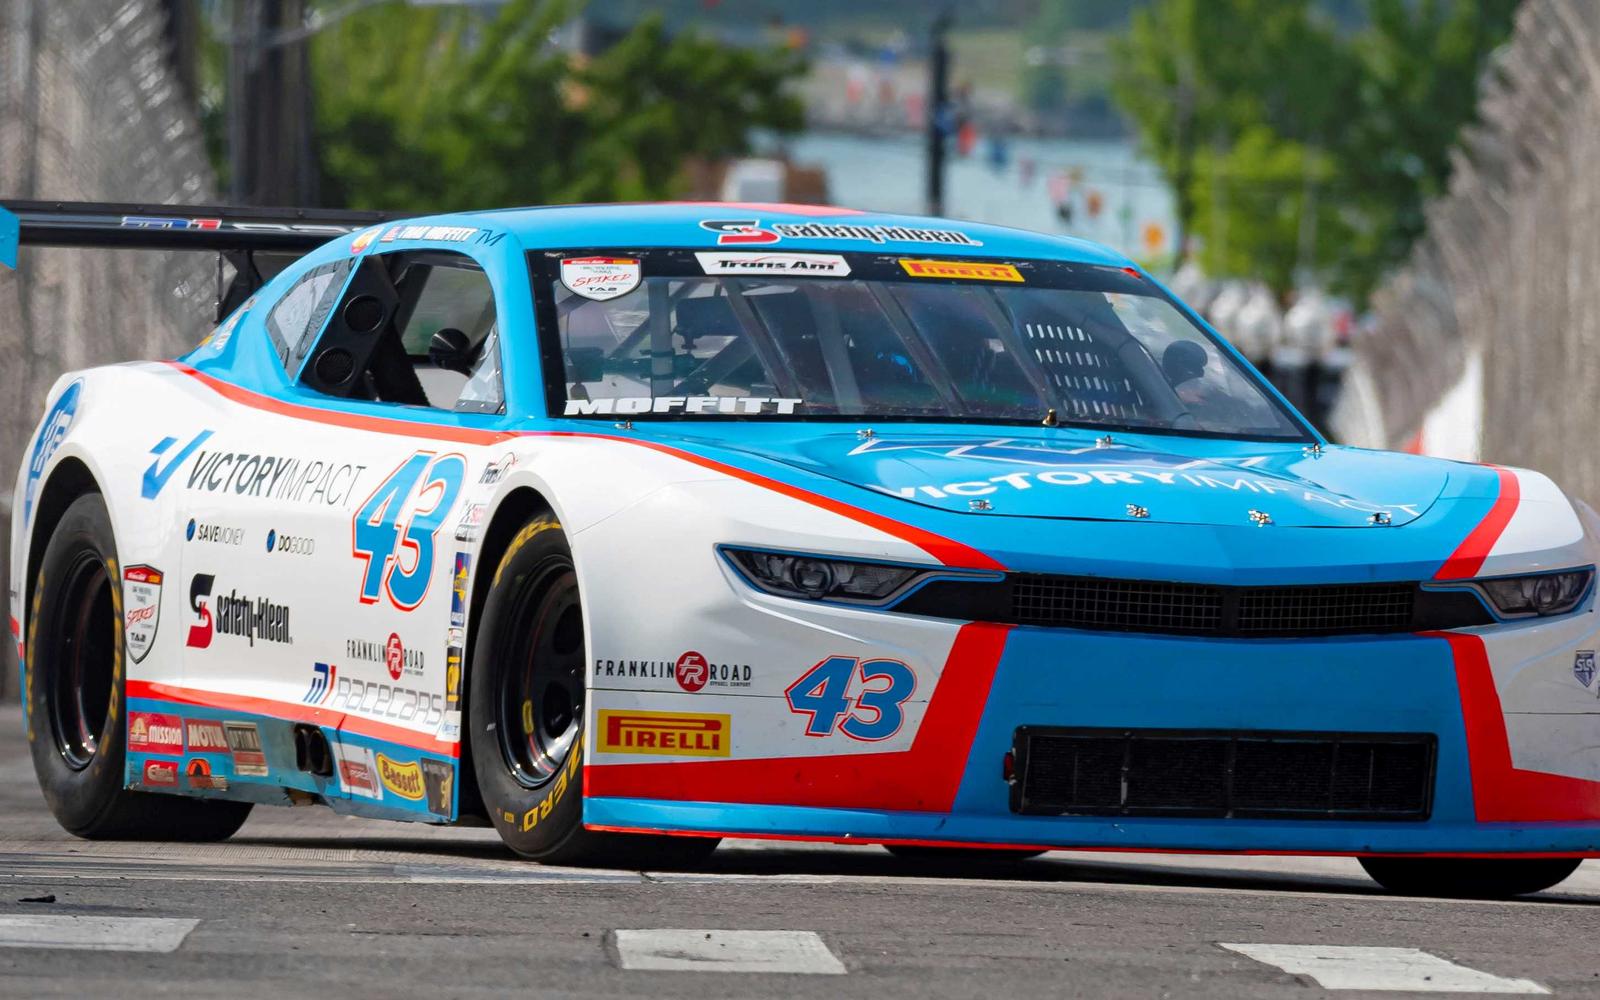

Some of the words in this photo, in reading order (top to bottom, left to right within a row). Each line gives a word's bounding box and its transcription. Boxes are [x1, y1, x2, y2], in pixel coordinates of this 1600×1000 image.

[719, 259, 785, 269] Trans
[790, 260, 834, 270] Am
[911, 263, 1013, 279] PIRELLI
[564, 397, 802, 416] MOFFITT
[352, 450, 468, 612] 43
[347, 640, 386, 662] FRANKLIN
[404, 649, 425, 670] ROAD
[595, 659, 674, 678] FRANKLIN
[710, 664, 752, 681] ROAD
[784, 655, 918, 742] 43
[188, 725, 228, 748] MOTUL
[607, 715, 722, 751] PIRELLI
[382, 758, 420, 794] Bassett
